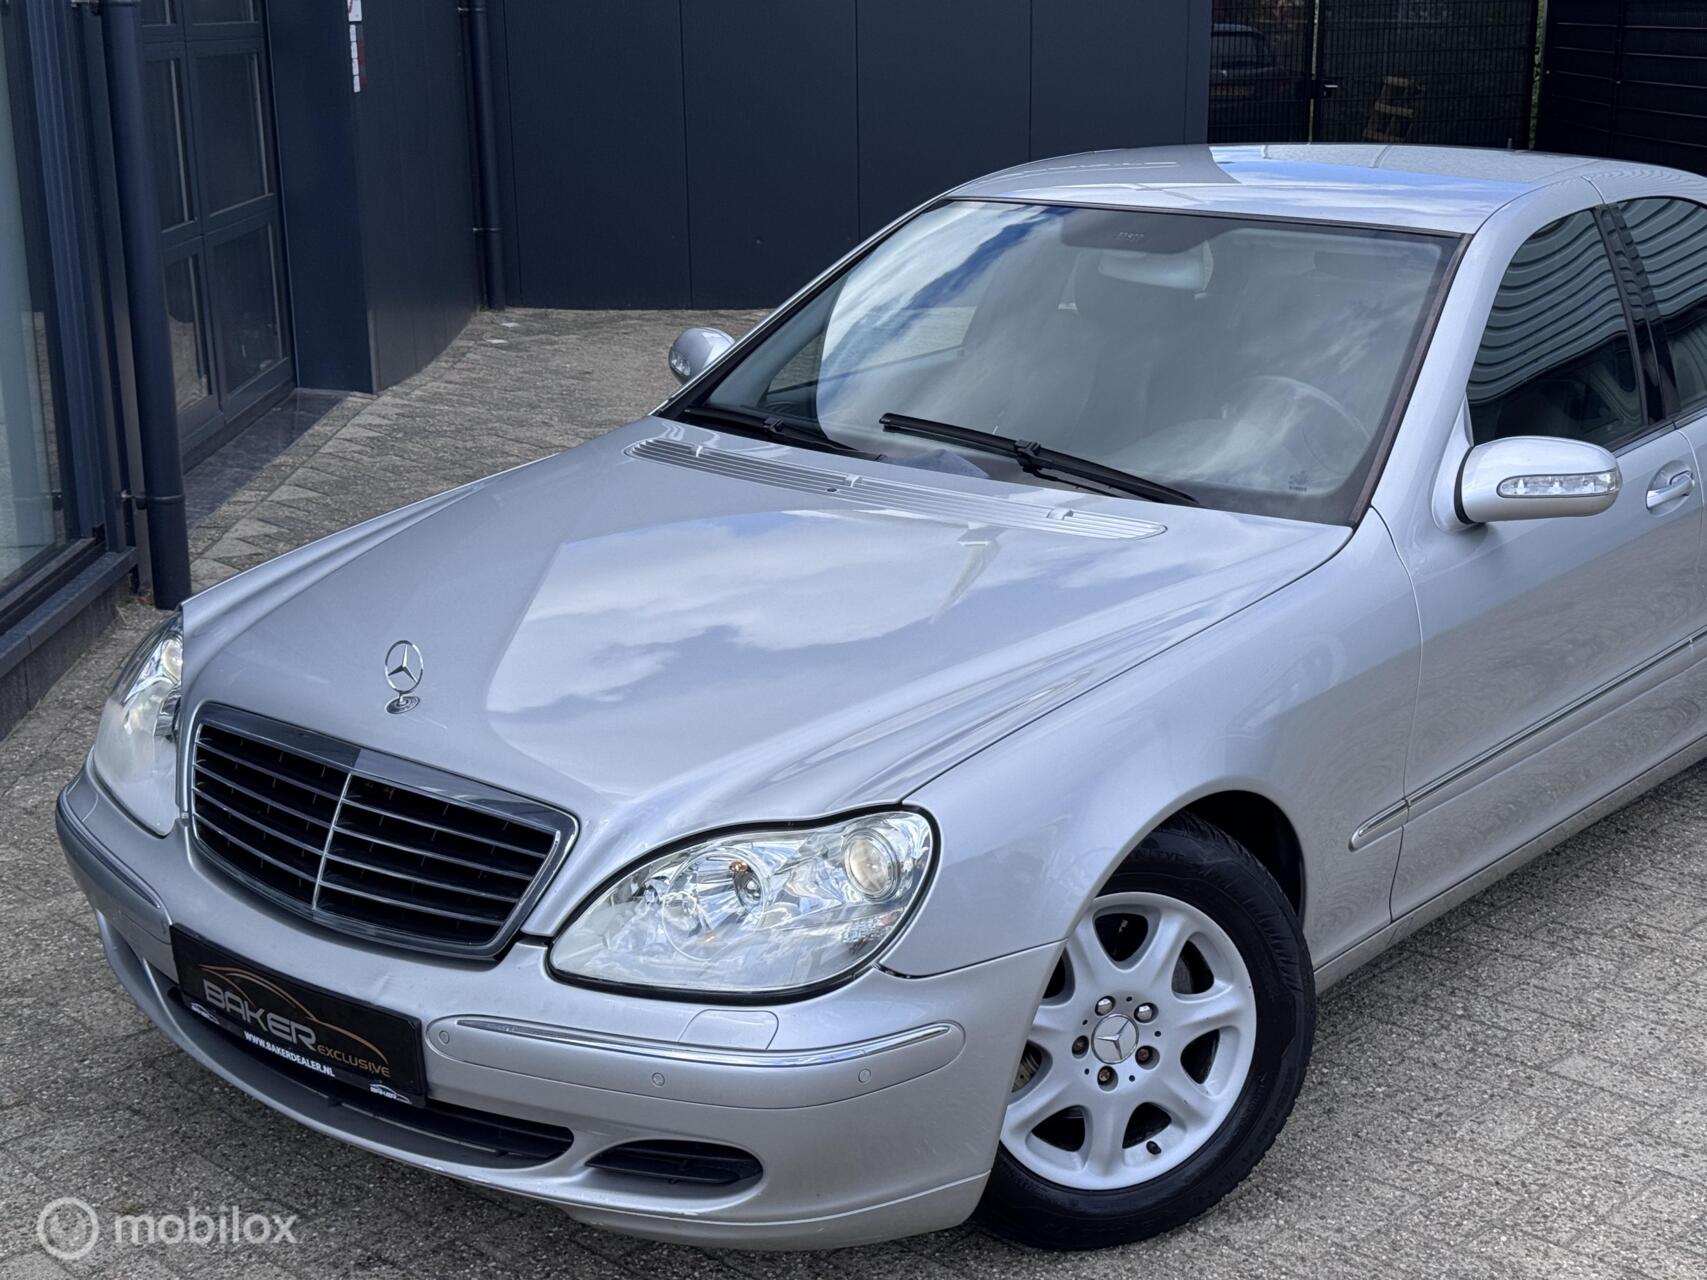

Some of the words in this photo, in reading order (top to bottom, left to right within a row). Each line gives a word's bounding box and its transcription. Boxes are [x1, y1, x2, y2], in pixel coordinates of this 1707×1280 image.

[203, 979, 317, 1052] BAKER
[317, 1045, 391, 1078] EXCLUSIVE
[244, 1031, 335, 1077] WWW.BAKERDEALER.NL
